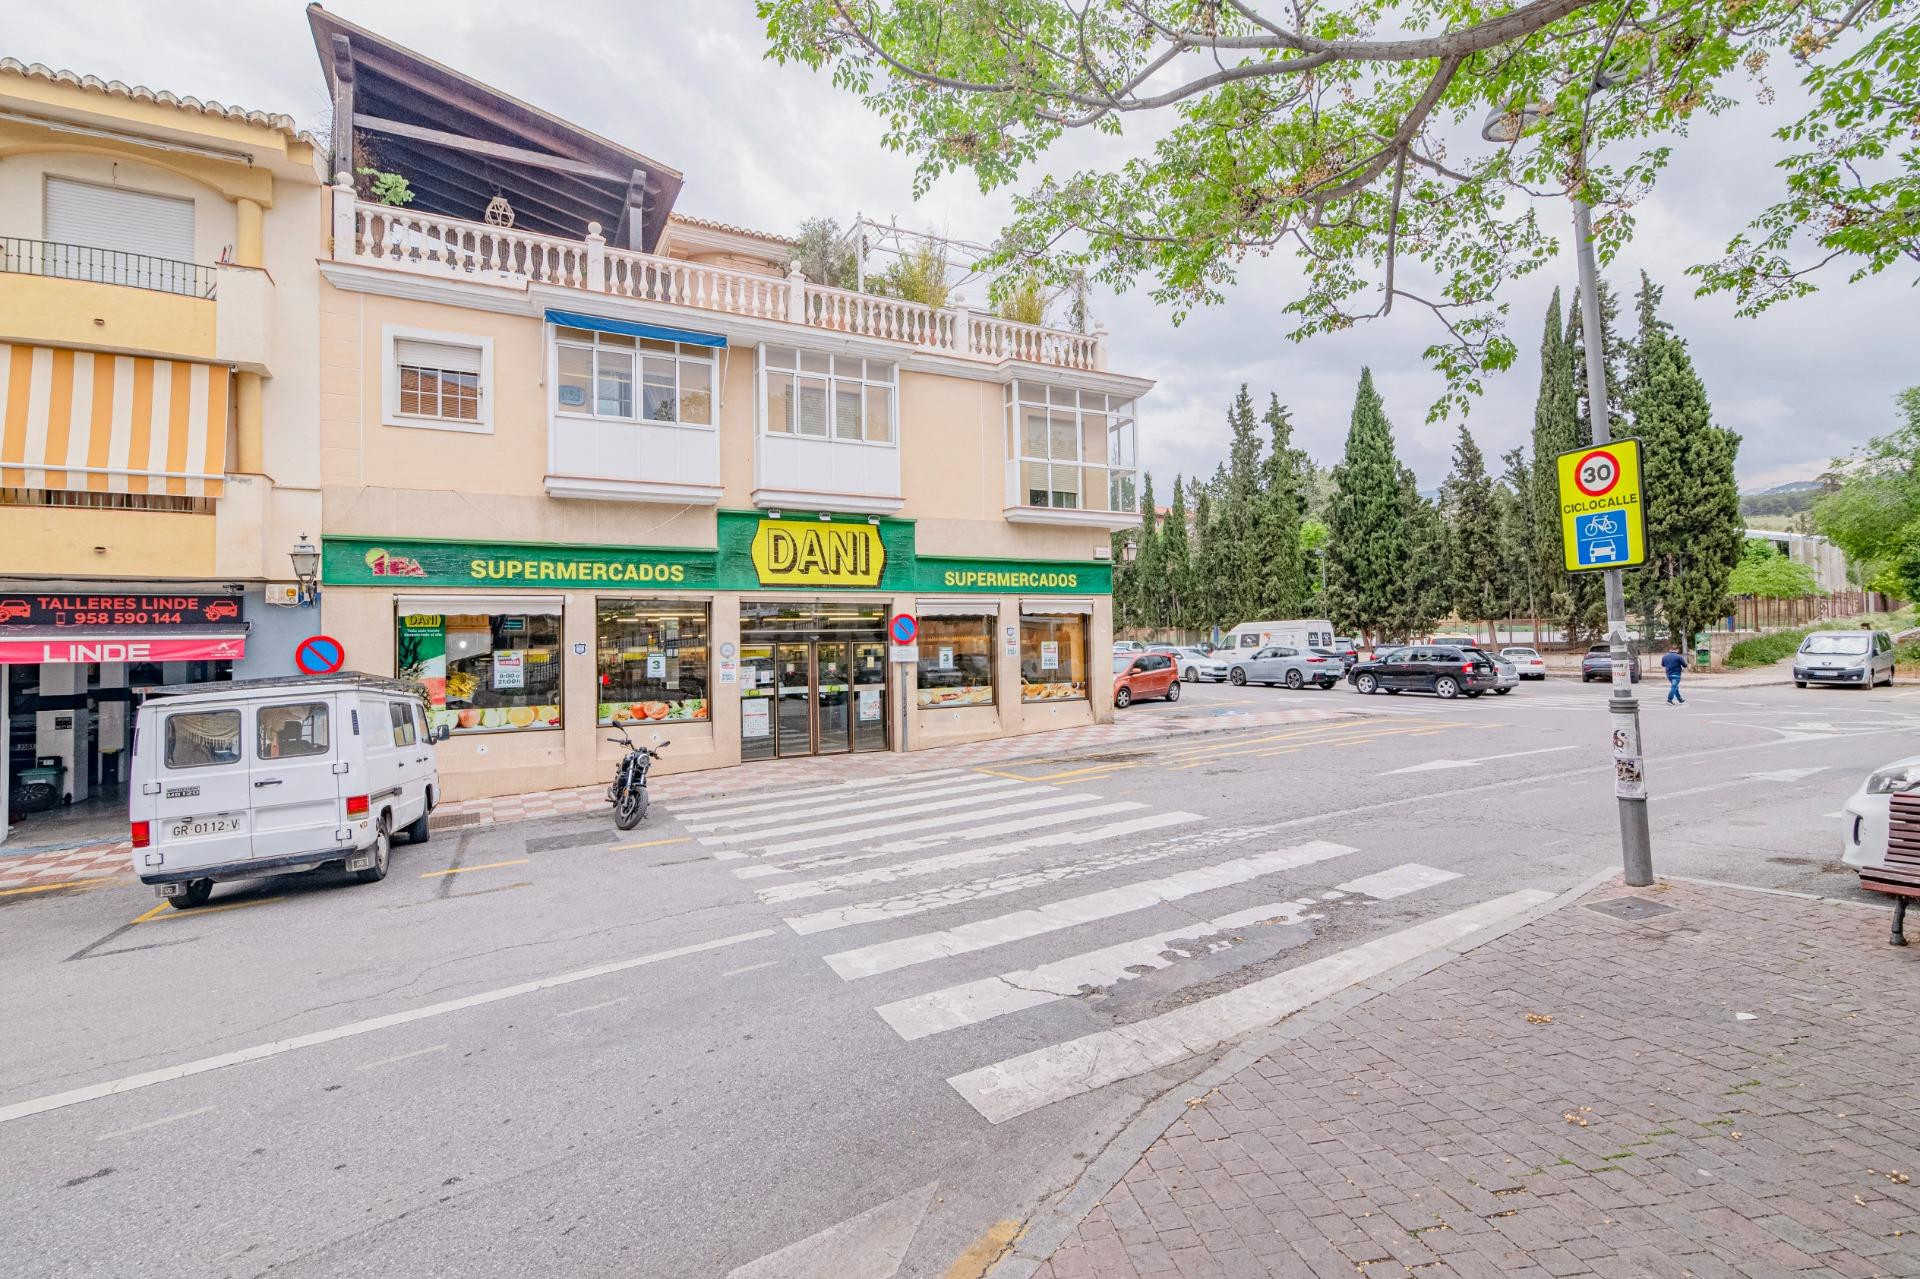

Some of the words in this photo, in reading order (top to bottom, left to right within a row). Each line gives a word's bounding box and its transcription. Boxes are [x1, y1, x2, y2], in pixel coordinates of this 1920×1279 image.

[1583, 464, 1611, 483] 30
[1563, 493, 1638, 514] CICLOCALLE
[767, 527, 870, 575] DANI
[470, 559, 684, 582] SUPERMERCADOS
[944, 571, 1077, 587] SUPERMERCADOS
[37, 597, 137, 610] TALLERES
[142, 598, 199, 609] LINDE
[74, 612, 109, 624] 958
[114, 612, 148, 624] 590
[152, 612, 182, 624] 144
[409, 615, 438, 625] DANI
[43, 644, 151, 663] LINDE
[943, 653, 949, 662] 3
[652, 660, 661, 670] 3
